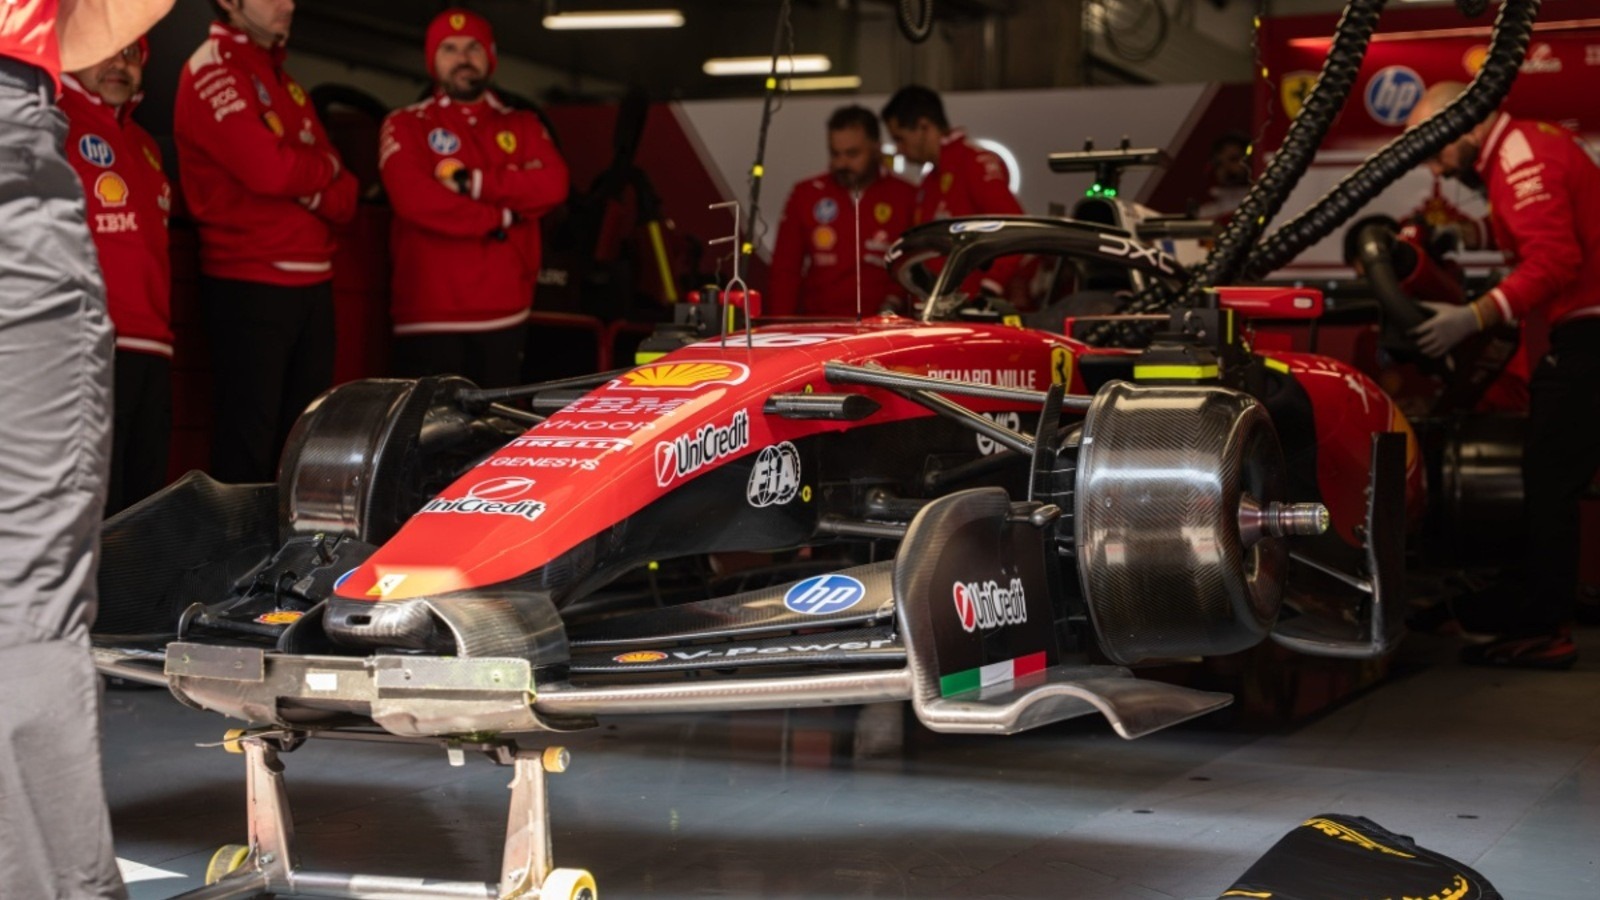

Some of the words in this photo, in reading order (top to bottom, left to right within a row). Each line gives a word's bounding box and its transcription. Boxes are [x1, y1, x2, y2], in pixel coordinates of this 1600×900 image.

[1371, 67, 1418, 124] hp
[83, 135, 111, 168] hp
[95, 212, 138, 233] IBM
[996, 369, 1036, 389] MILLE
[676, 411, 748, 475] UniCredit
[491, 457, 600, 471] GENESYS
[789, 575, 860, 614] hp
[966, 578, 1027, 629] UniCredit
[673, 639, 893, 660] V-Power
